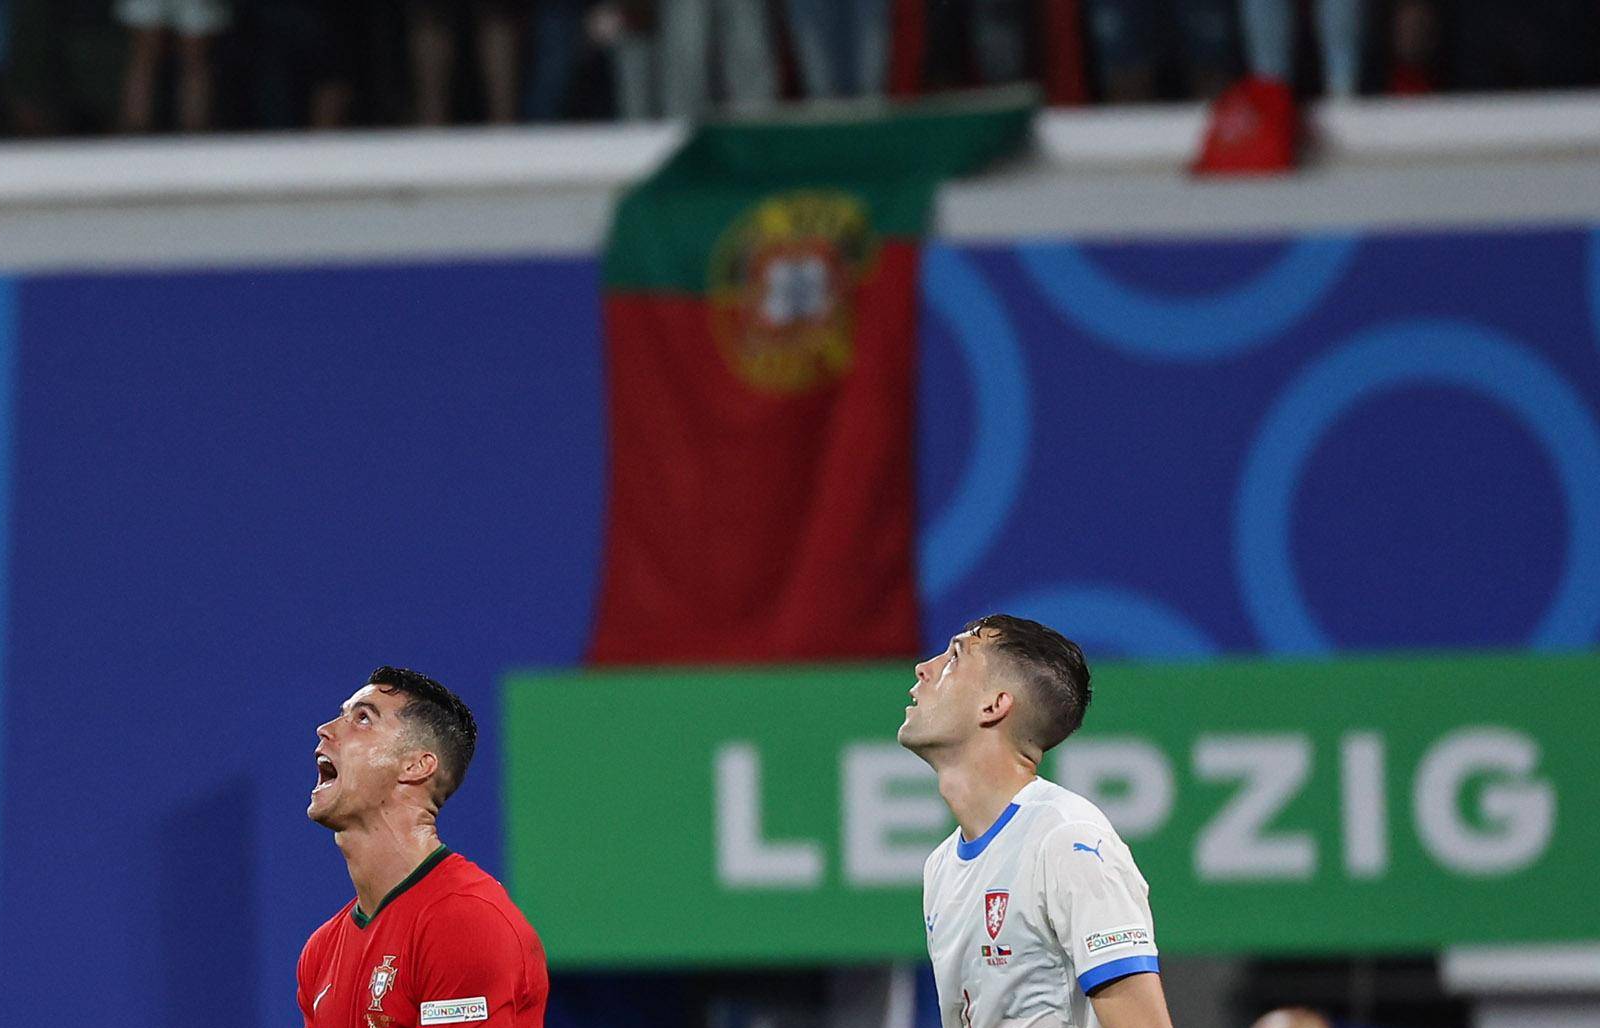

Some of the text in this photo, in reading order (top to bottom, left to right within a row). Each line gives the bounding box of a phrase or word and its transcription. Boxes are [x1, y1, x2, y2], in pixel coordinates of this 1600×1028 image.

[712, 727, 1555, 889] LEPZIG
[1087, 931, 1148, 949] FOUNDATION
[422, 1004, 485, 1017] FOUNDATION
